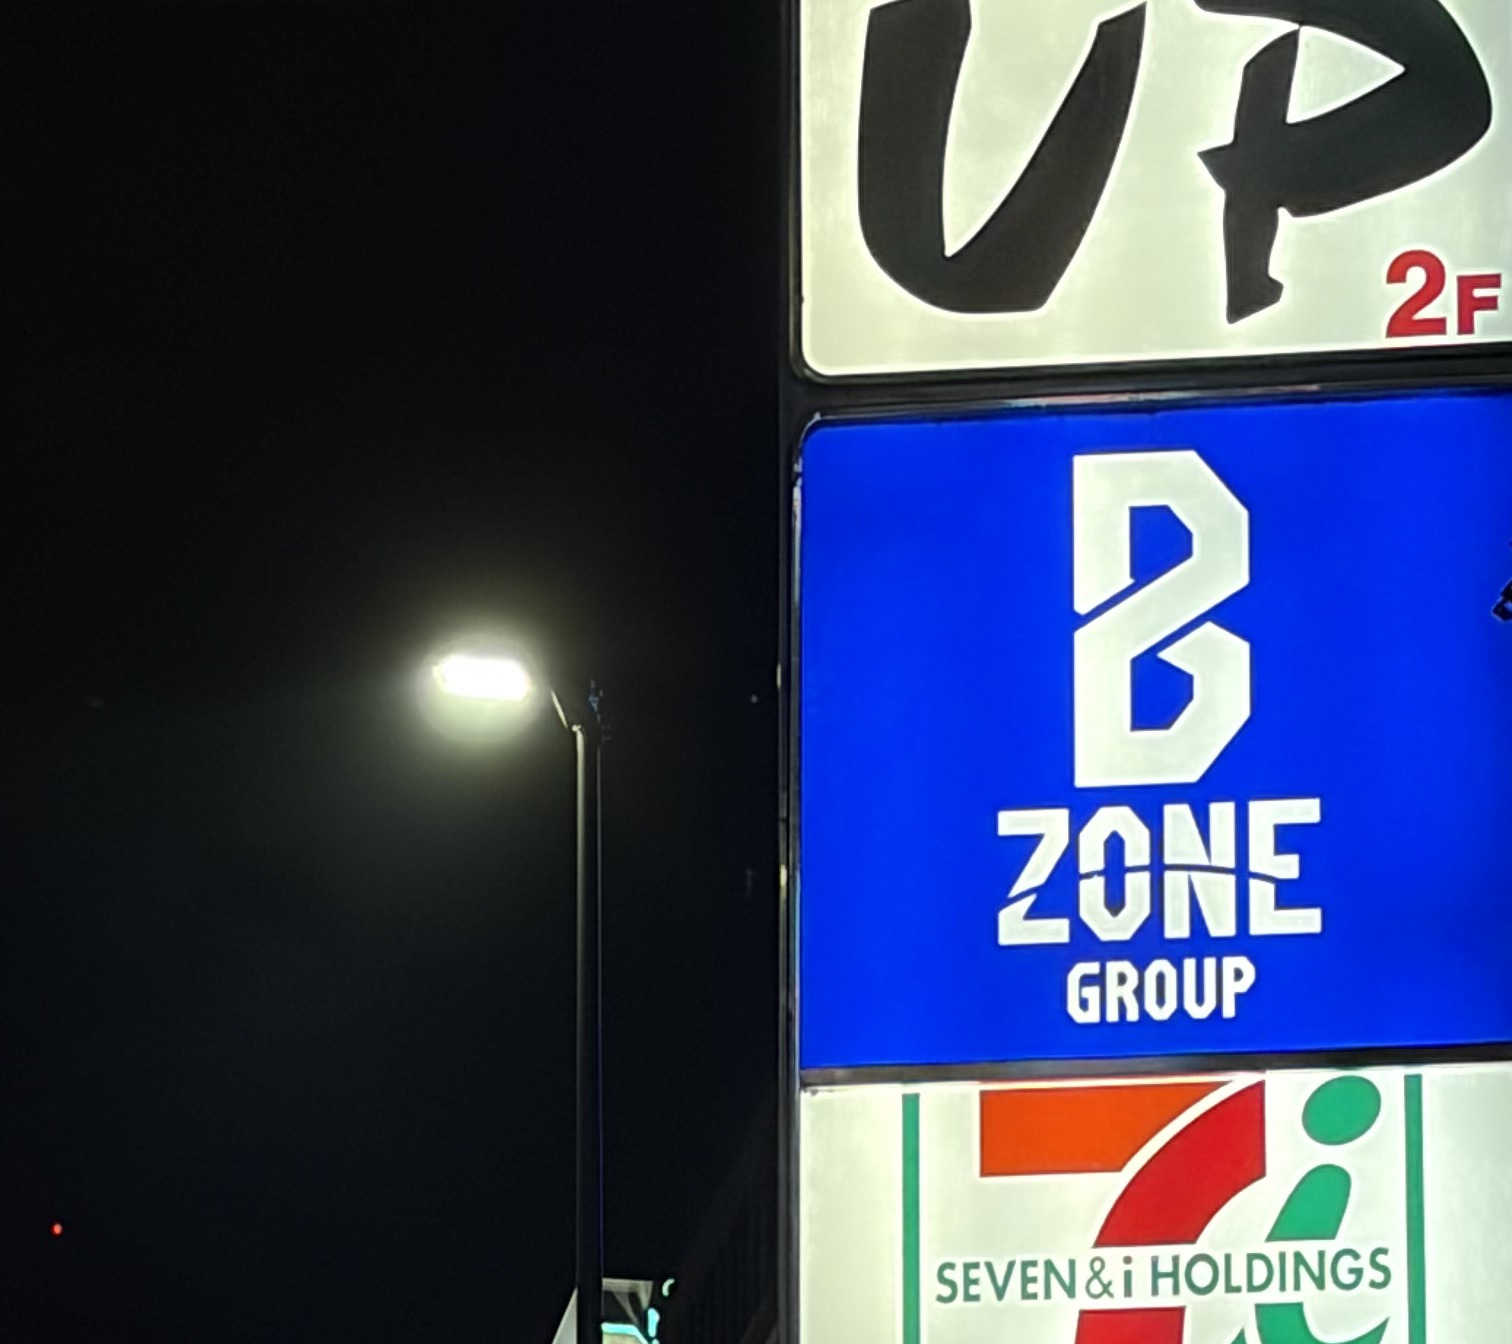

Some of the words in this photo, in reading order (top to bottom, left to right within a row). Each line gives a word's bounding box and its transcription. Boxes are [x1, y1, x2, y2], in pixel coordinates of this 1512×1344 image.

[1385, 250, 1503, 338] 2F
[997, 798, 1322, 946] ZONE
[1066, 955, 1256, 1024] GROUP
[1150, 1247, 1392, 1298] HOLDINGS
